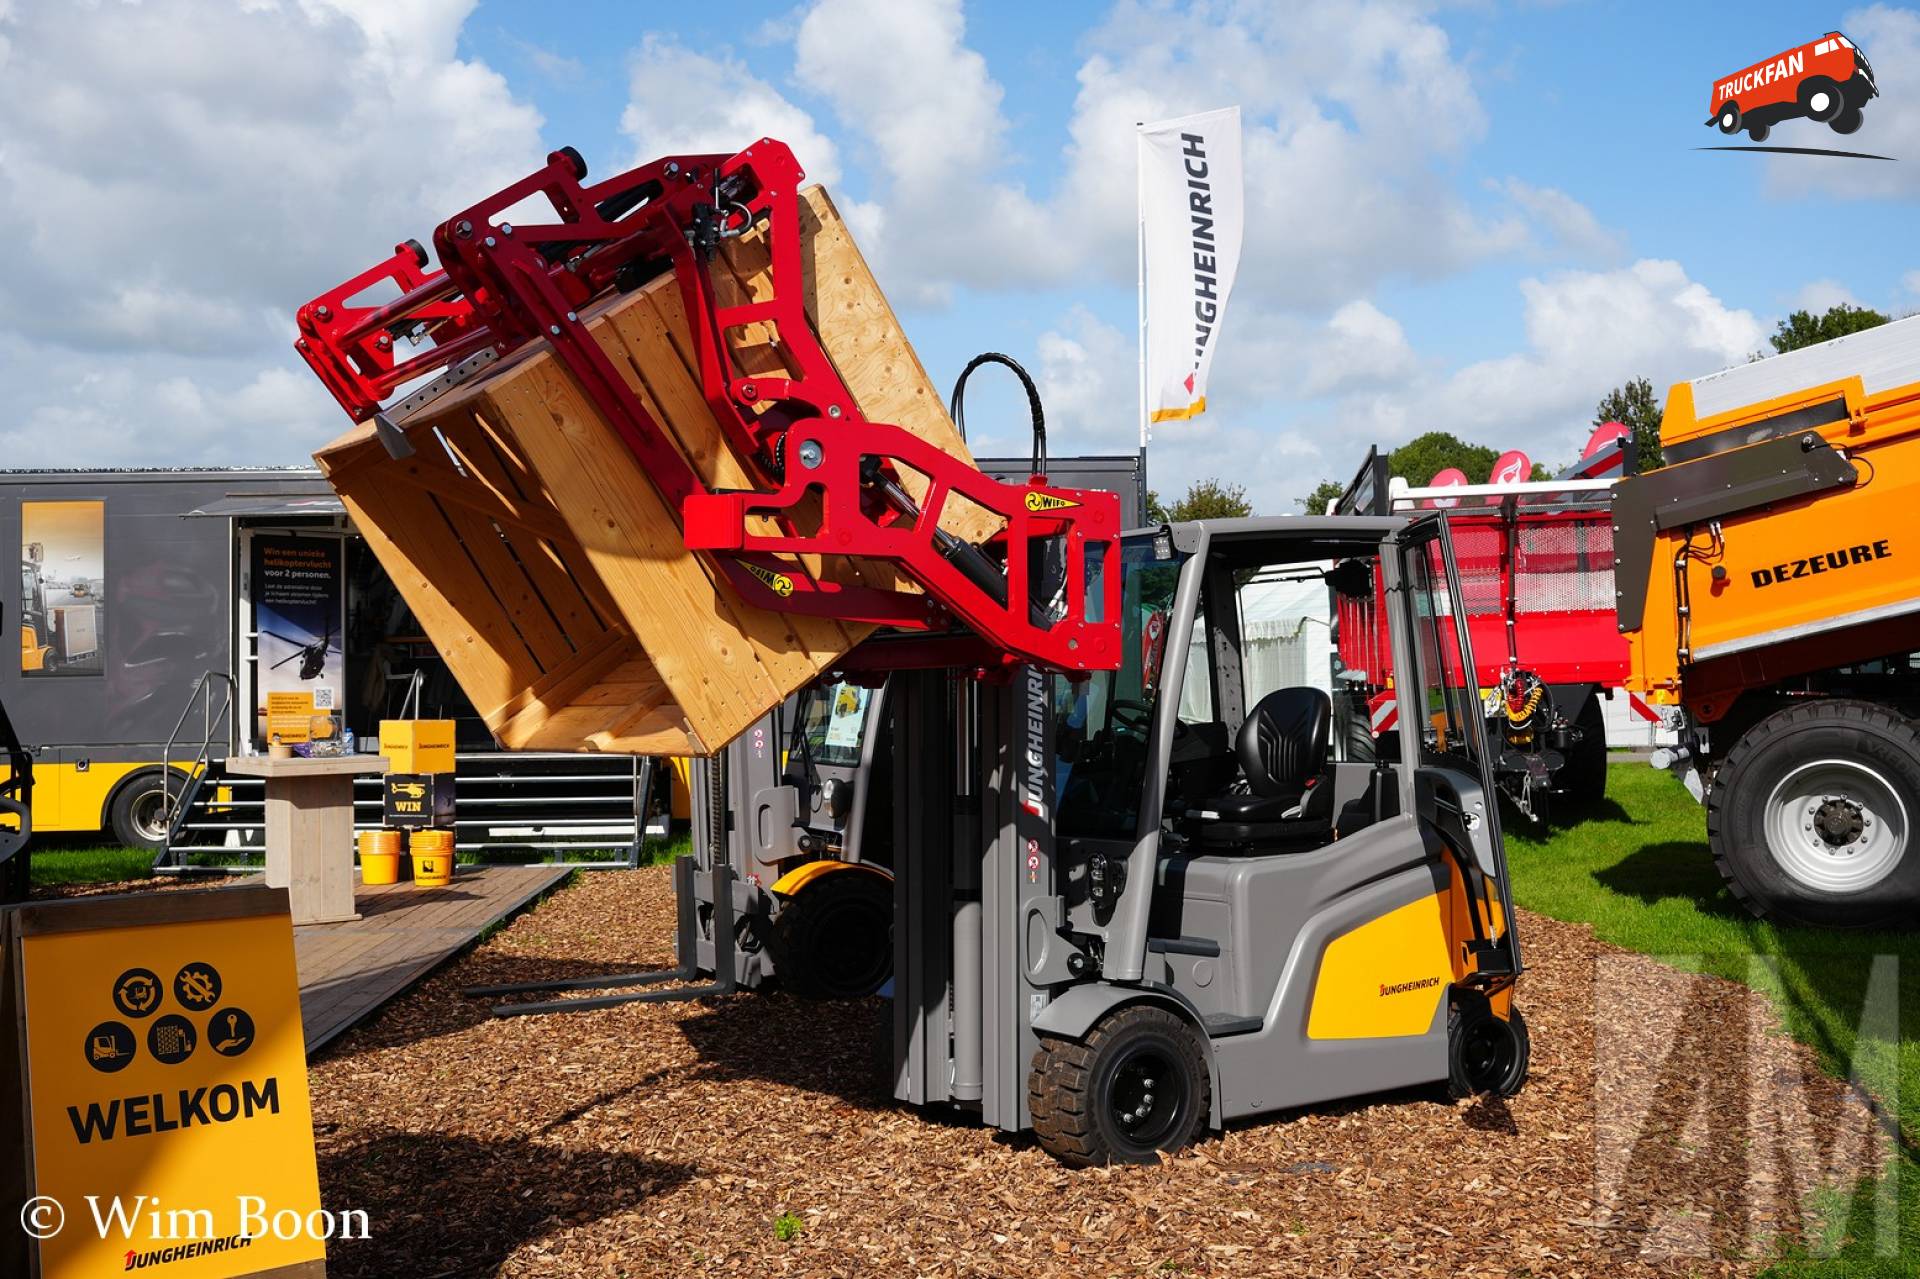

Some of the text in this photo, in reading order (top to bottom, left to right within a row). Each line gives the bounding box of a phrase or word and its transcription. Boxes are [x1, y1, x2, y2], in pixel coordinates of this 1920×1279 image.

[1181, 132, 1217, 395] NGHEINRICH
[285, 569, 290, 577] 2
[292, 571, 331, 579] personen.
[1751, 539, 1892, 588] DEZEURE
[395, 801, 421, 812] WIN
[1379, 977, 1440, 996] JUNGHEINRICH
[67, 1077, 280, 1144] WELKOM
[124, 1232, 252, 1271] JUNGHEINRICH
